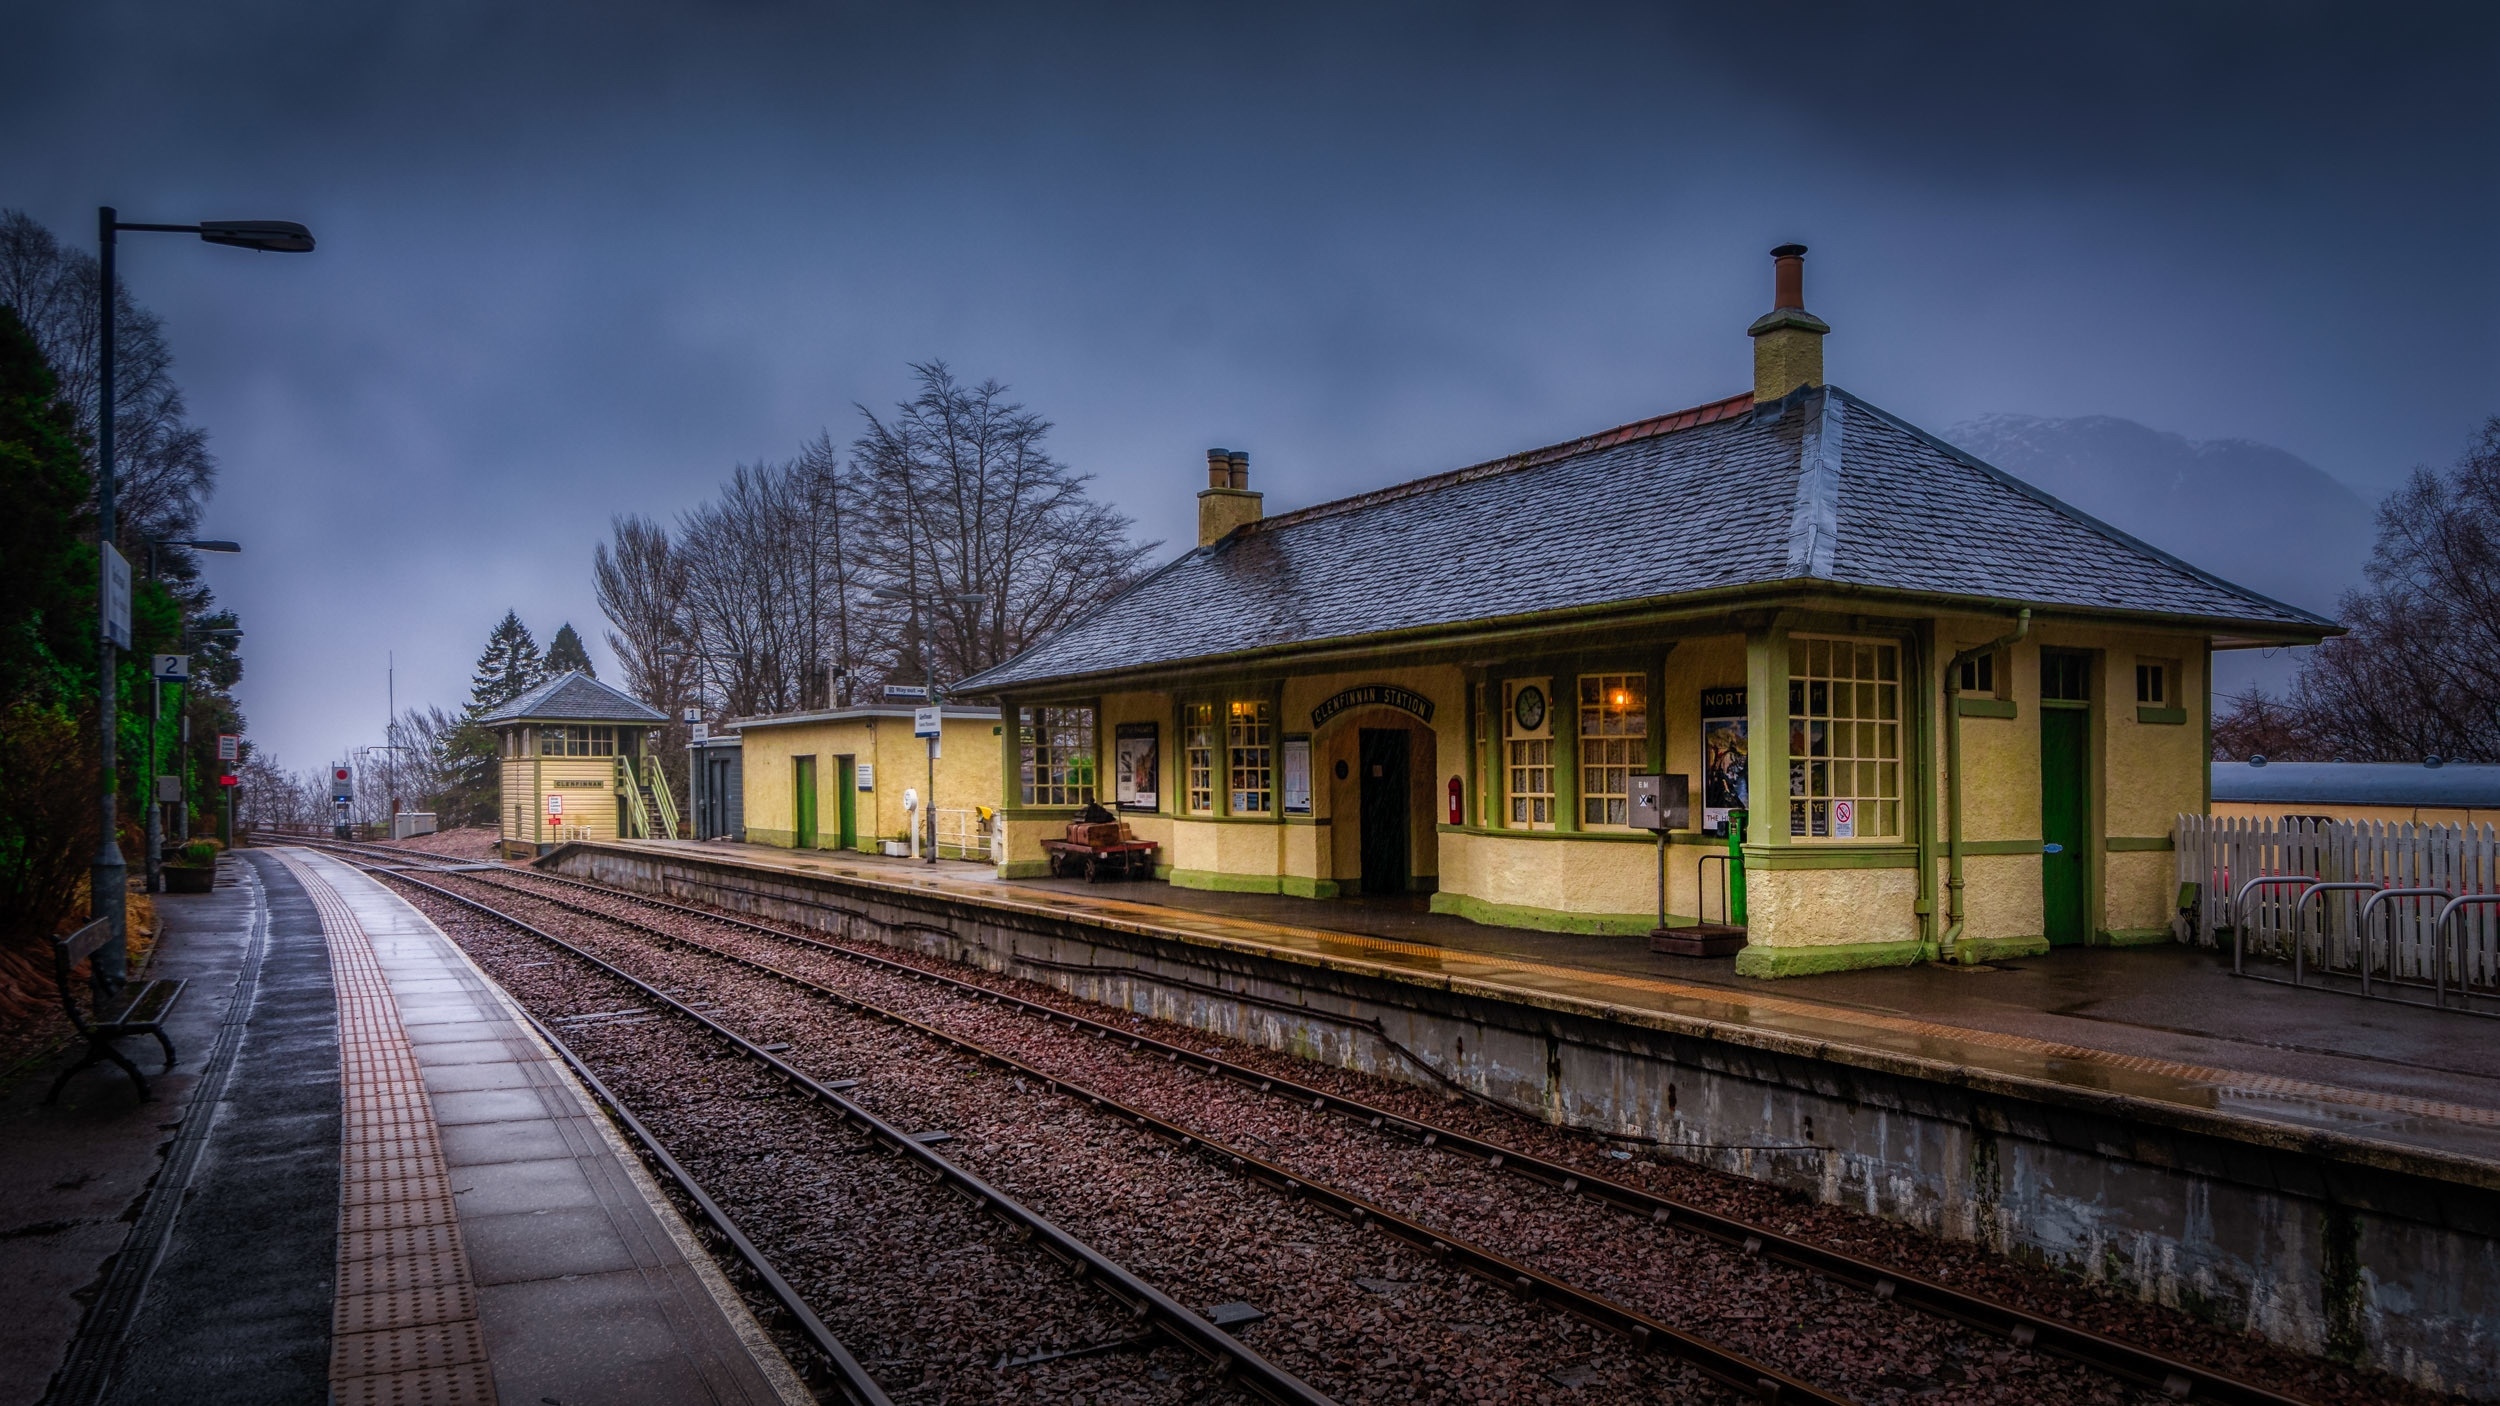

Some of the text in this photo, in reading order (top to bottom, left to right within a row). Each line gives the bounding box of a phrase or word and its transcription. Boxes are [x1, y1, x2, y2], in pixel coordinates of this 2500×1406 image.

[165, 656, 178, 674] 2
[1384, 689, 1426, 717] STATION
[1705, 692, 1748, 706] NORT
[689, 709, 696, 719] 1
[1801, 803, 1825, 813] SYE
[1706, 814, 1719, 822] THE
